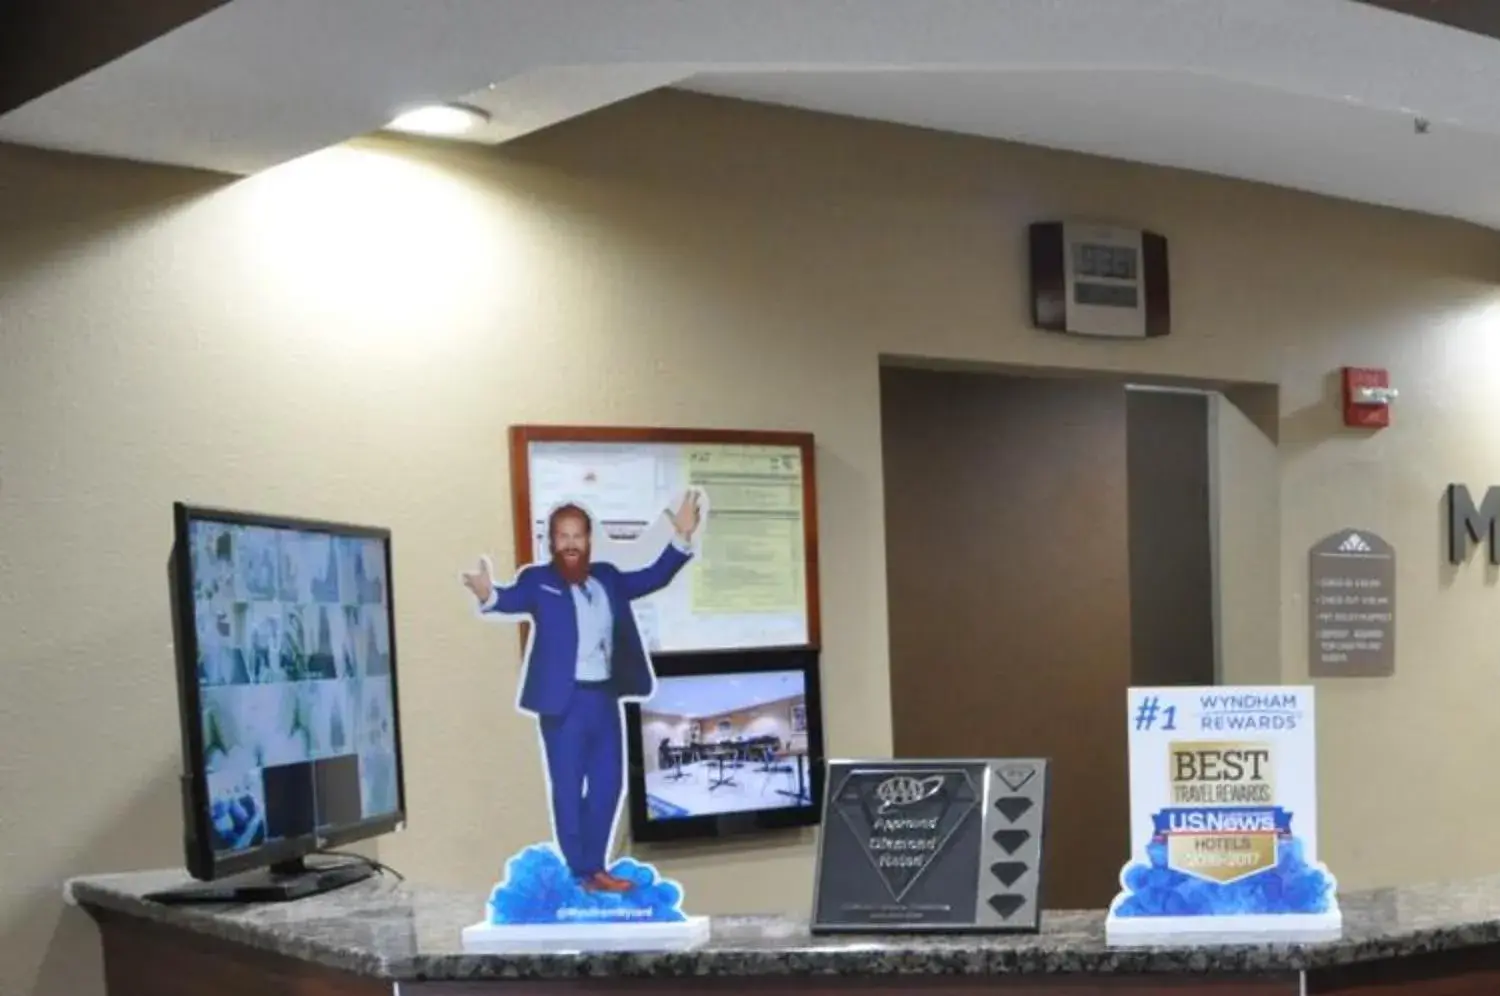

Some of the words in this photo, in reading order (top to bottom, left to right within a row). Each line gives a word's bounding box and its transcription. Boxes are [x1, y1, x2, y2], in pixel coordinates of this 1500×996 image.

[1199, 694, 1297, 709] WYNDHAM
[1134, 695, 1177, 731] #1
[1200, 715, 1297, 731] REWARDS
[1173, 749, 1270, 782] BEST
[1174, 784, 1216, 803] TRAVEL
[1216, 784, 1271, 803] REWARDS
[1194, 838, 1252, 851] HOTELS
